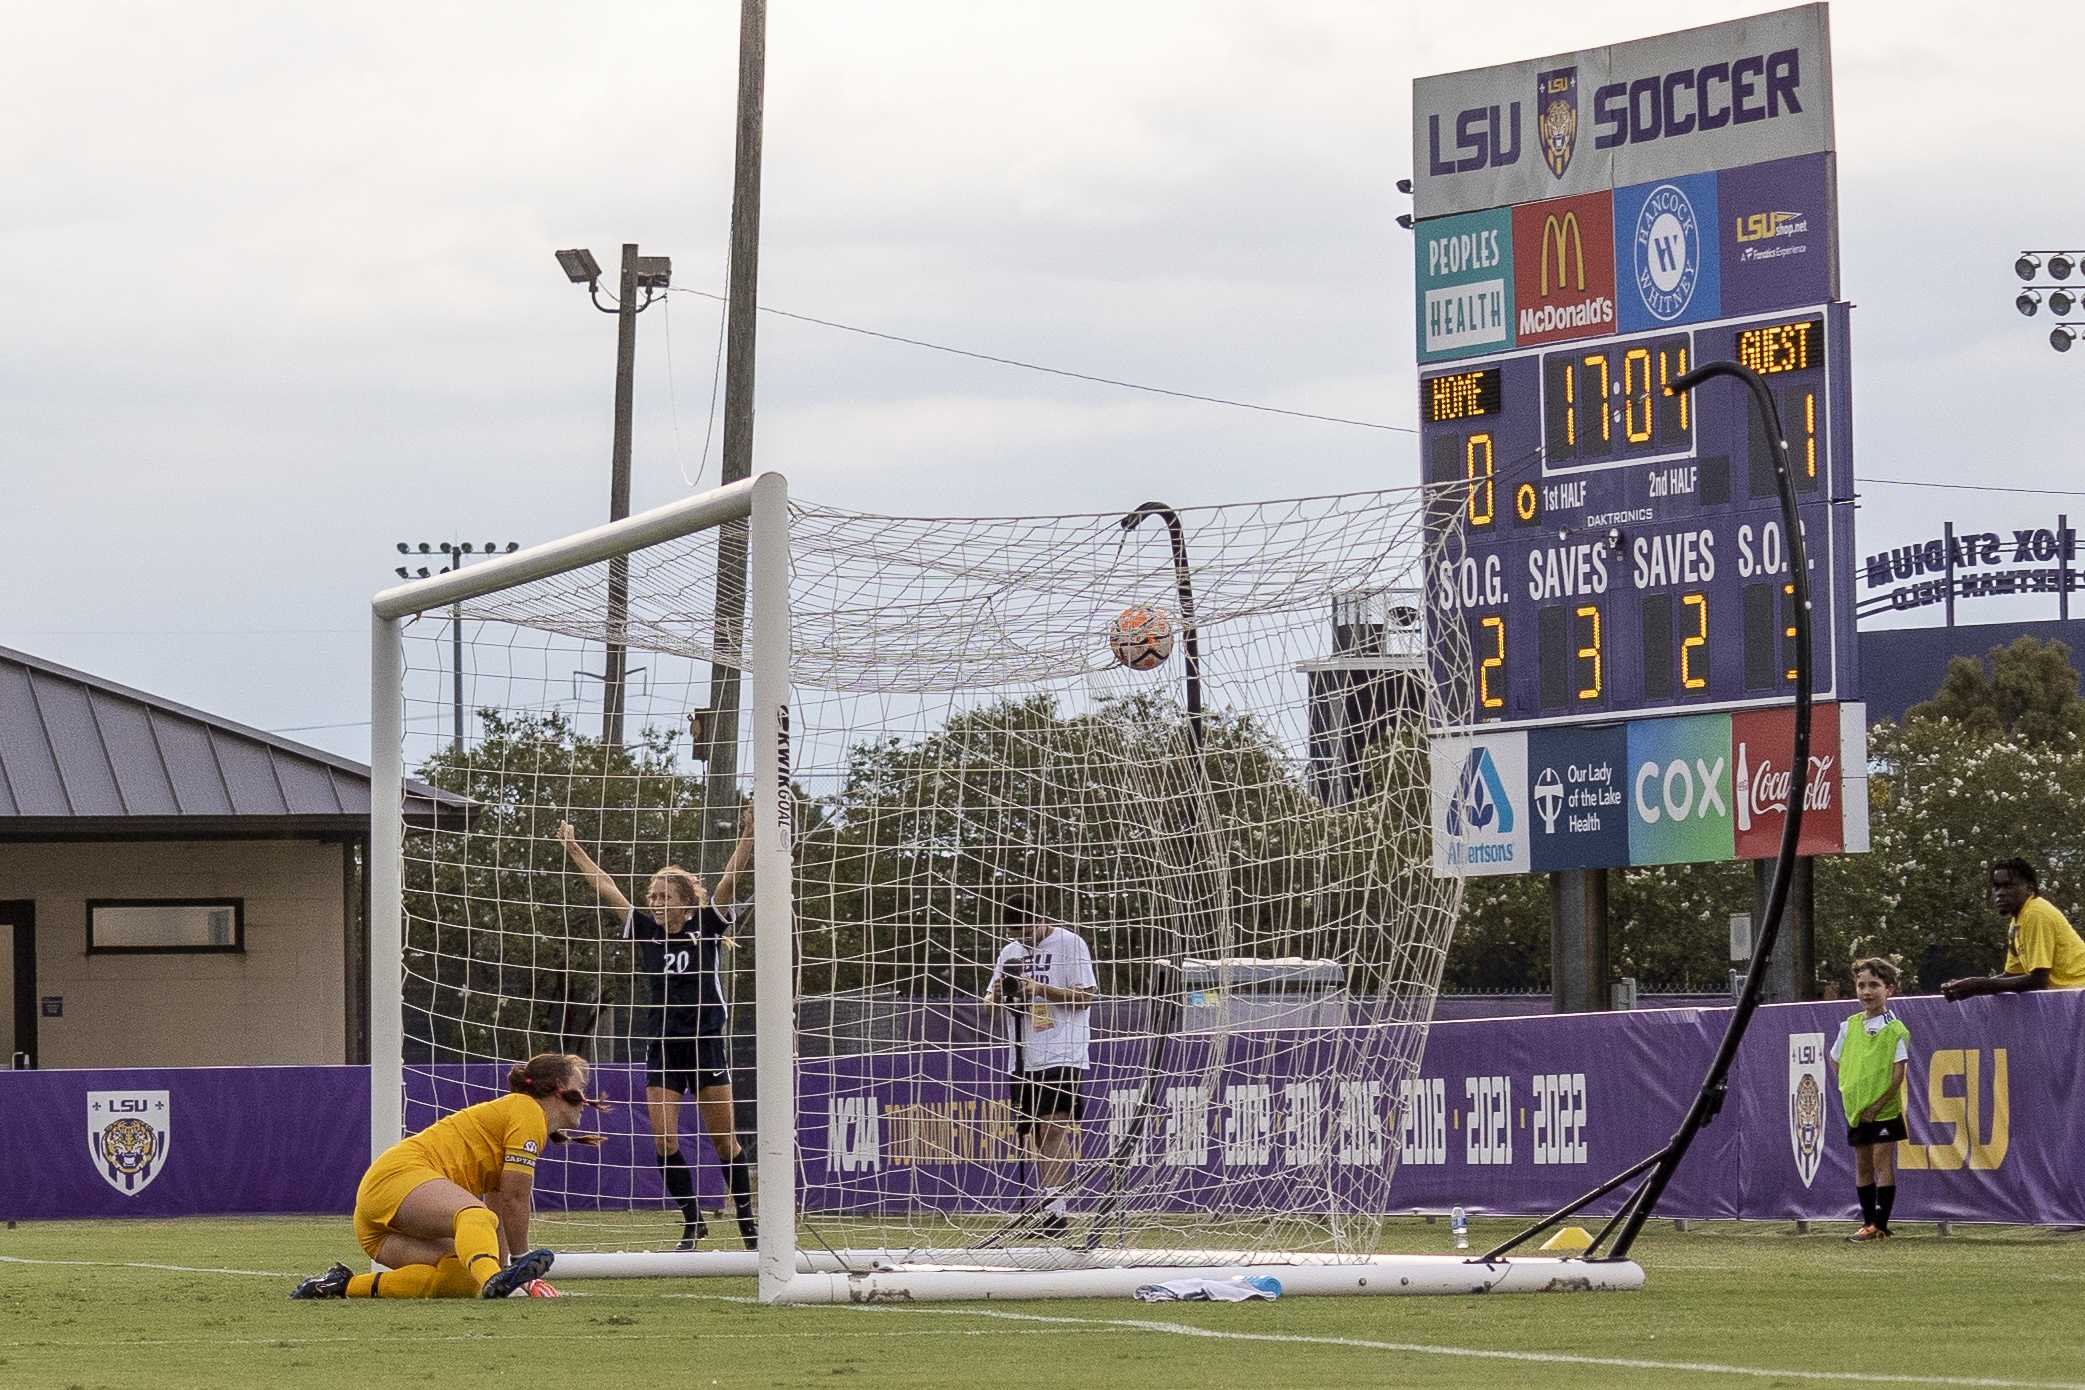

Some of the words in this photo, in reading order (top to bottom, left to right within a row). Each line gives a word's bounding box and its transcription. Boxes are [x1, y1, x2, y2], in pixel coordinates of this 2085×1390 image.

[1548, 77, 1568, 93] LSU
[1594, 48, 1803, 150] SOCCER
[1429, 101, 1521, 176] LSU
[1638, 192, 1694, 246] HANCOCK
[1429, 229, 1500, 277] PEOPLES
[1640, 260, 1695, 313] WHITNEY
[1431, 290, 1501, 337] HEALTH
[1520, 297, 1613, 336] McDonald's
[1739, 324, 1812, 374] GUEST
[1432, 372, 1486, 421] HOME
[1564, 348, 1689, 446] 17:04
[1805, 393, 1817, 478] 1
[1467, 434, 1494, 526] 0
[1543, 486, 1559, 511] 1st
[1560, 481, 1587, 509] HALF
[1648, 473, 1669, 498] 2nd
[1670, 467, 1698, 495] HALF
[1586, 508, 1653, 528] DAKTRONICS
[1529, 542, 1608, 601] SAVES
[1633, 529, 1715, 589] SAVES
[1737, 520, 1815, 578] S.O..
[1480, 616, 1504, 709] 2
[1577, 606, 1600, 699] 3
[1682, 594, 1707, 689] 2
[1567, 764, 1587, 783] Our
[1588, 762, 1612, 784] Lady
[1568, 789, 1579, 808] of
[1580, 789, 1598, 807] the
[1599, 788, 1622, 806] Lake
[1635, 756, 1726, 824] COX
[1569, 814, 1601, 833] Health
[1447, 842, 1513, 865] Alertsons
[663, 950, 690, 974] 20
[1024, 953, 1052, 972] SU
[1798, 1046, 1816, 1064] LSU
[108, 1099, 148, 1112] LSU
[1225, 1085, 1270, 1165] 2009
[1401, 1079, 1446, 1164] 2018
[1466, 1076, 1512, 1164] 2021
[1533, 1074, 1588, 1164] 2022
[1897, 1048, 2010, 1170] LSU
[828, 1097, 880, 1172] NCAA
